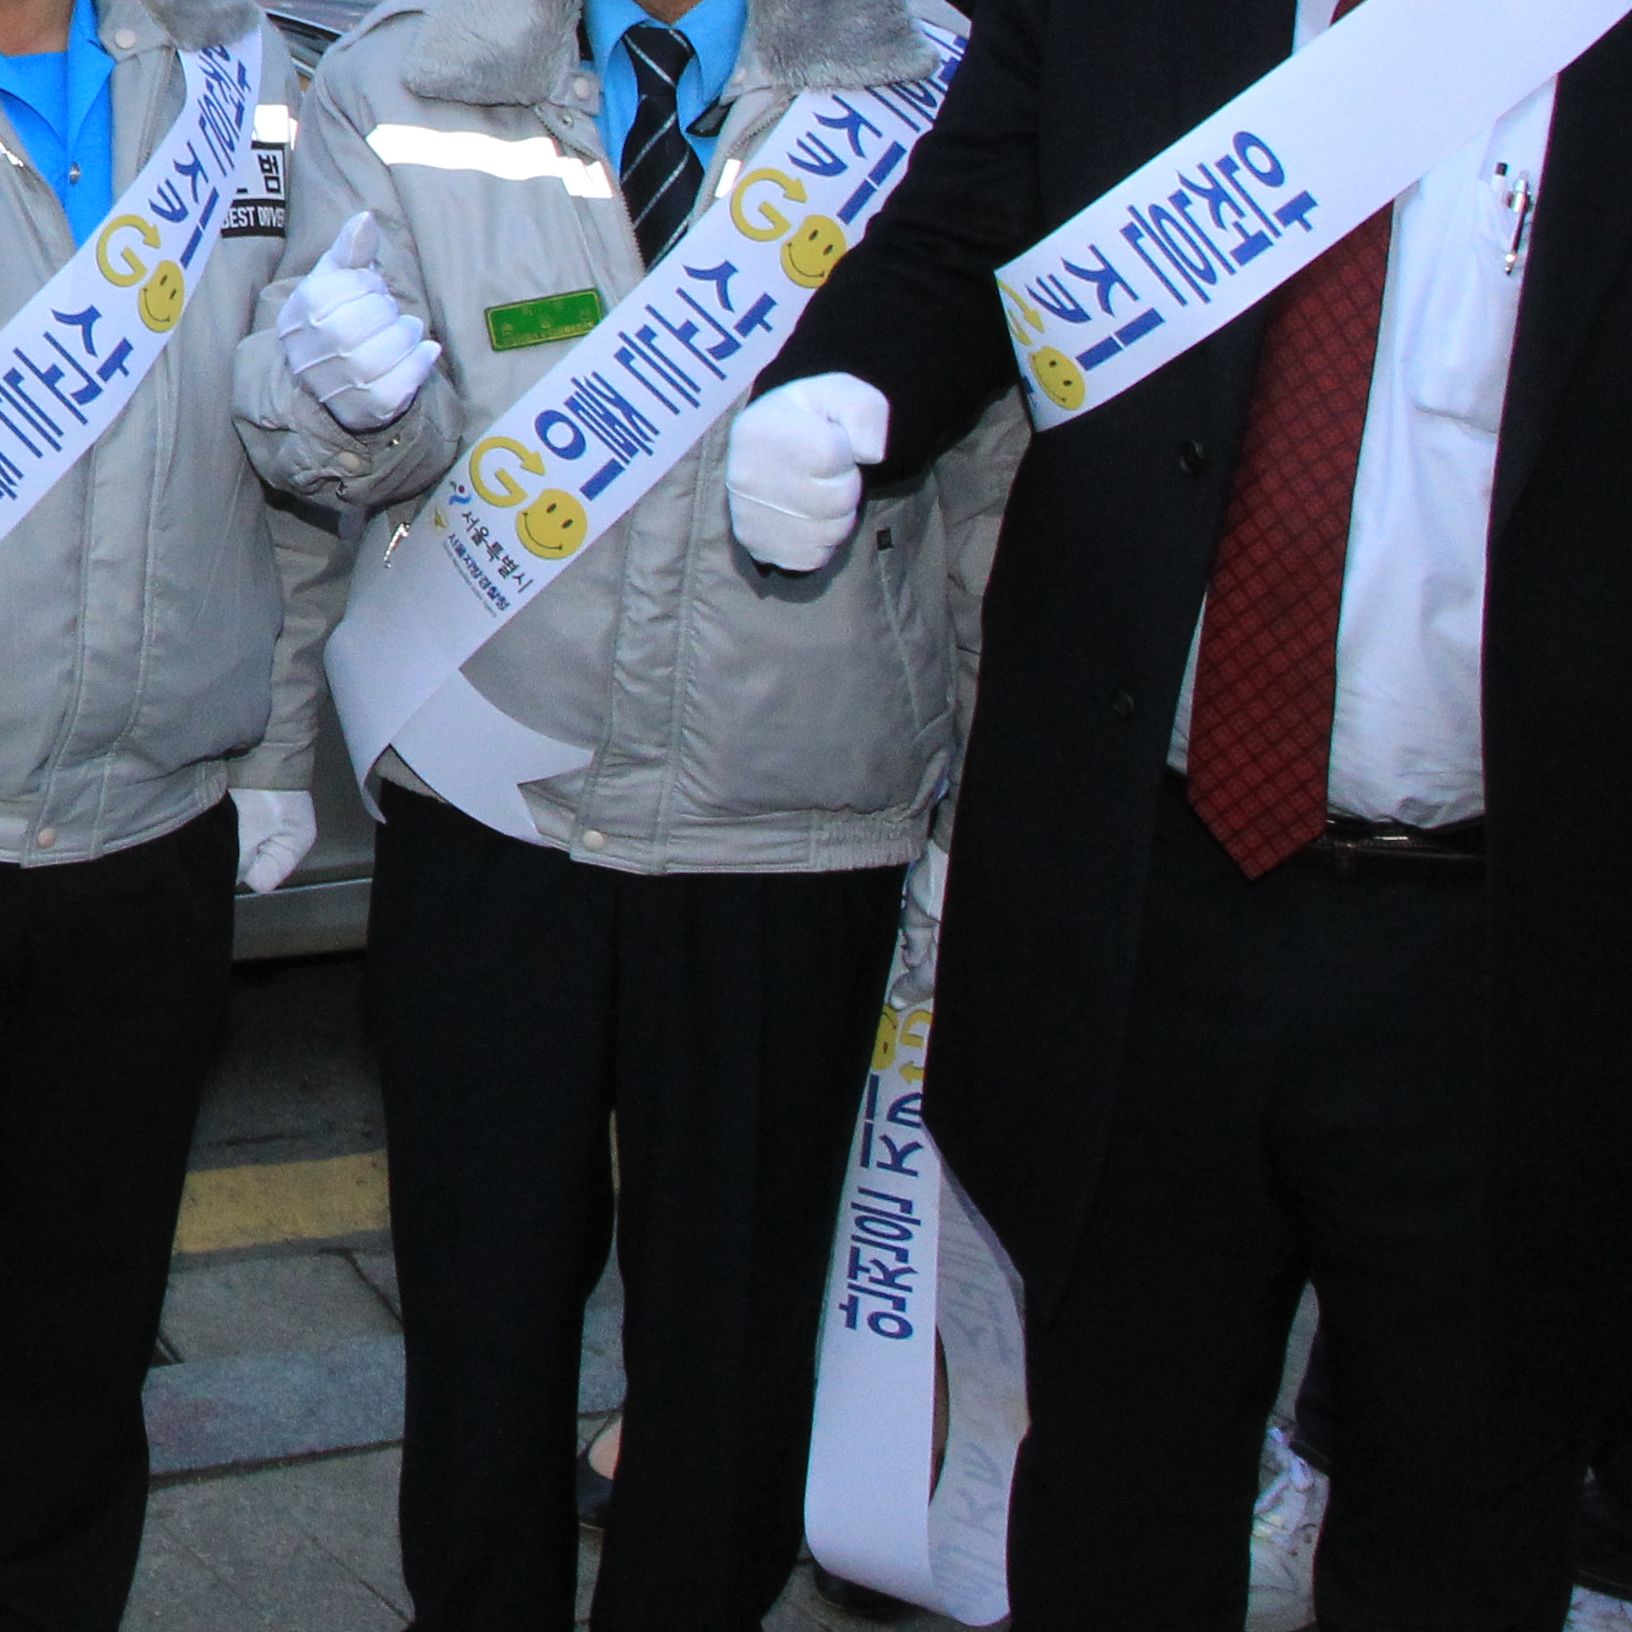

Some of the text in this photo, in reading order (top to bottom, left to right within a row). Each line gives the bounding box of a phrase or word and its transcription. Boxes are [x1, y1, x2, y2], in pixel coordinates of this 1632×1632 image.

[1118, 128, 1322, 310] 안전은
[617, 258, 778, 418] 사고는
[462, 514, 534, 594] 서울특별시
[838, 1185, 923, 1341] 안전은
